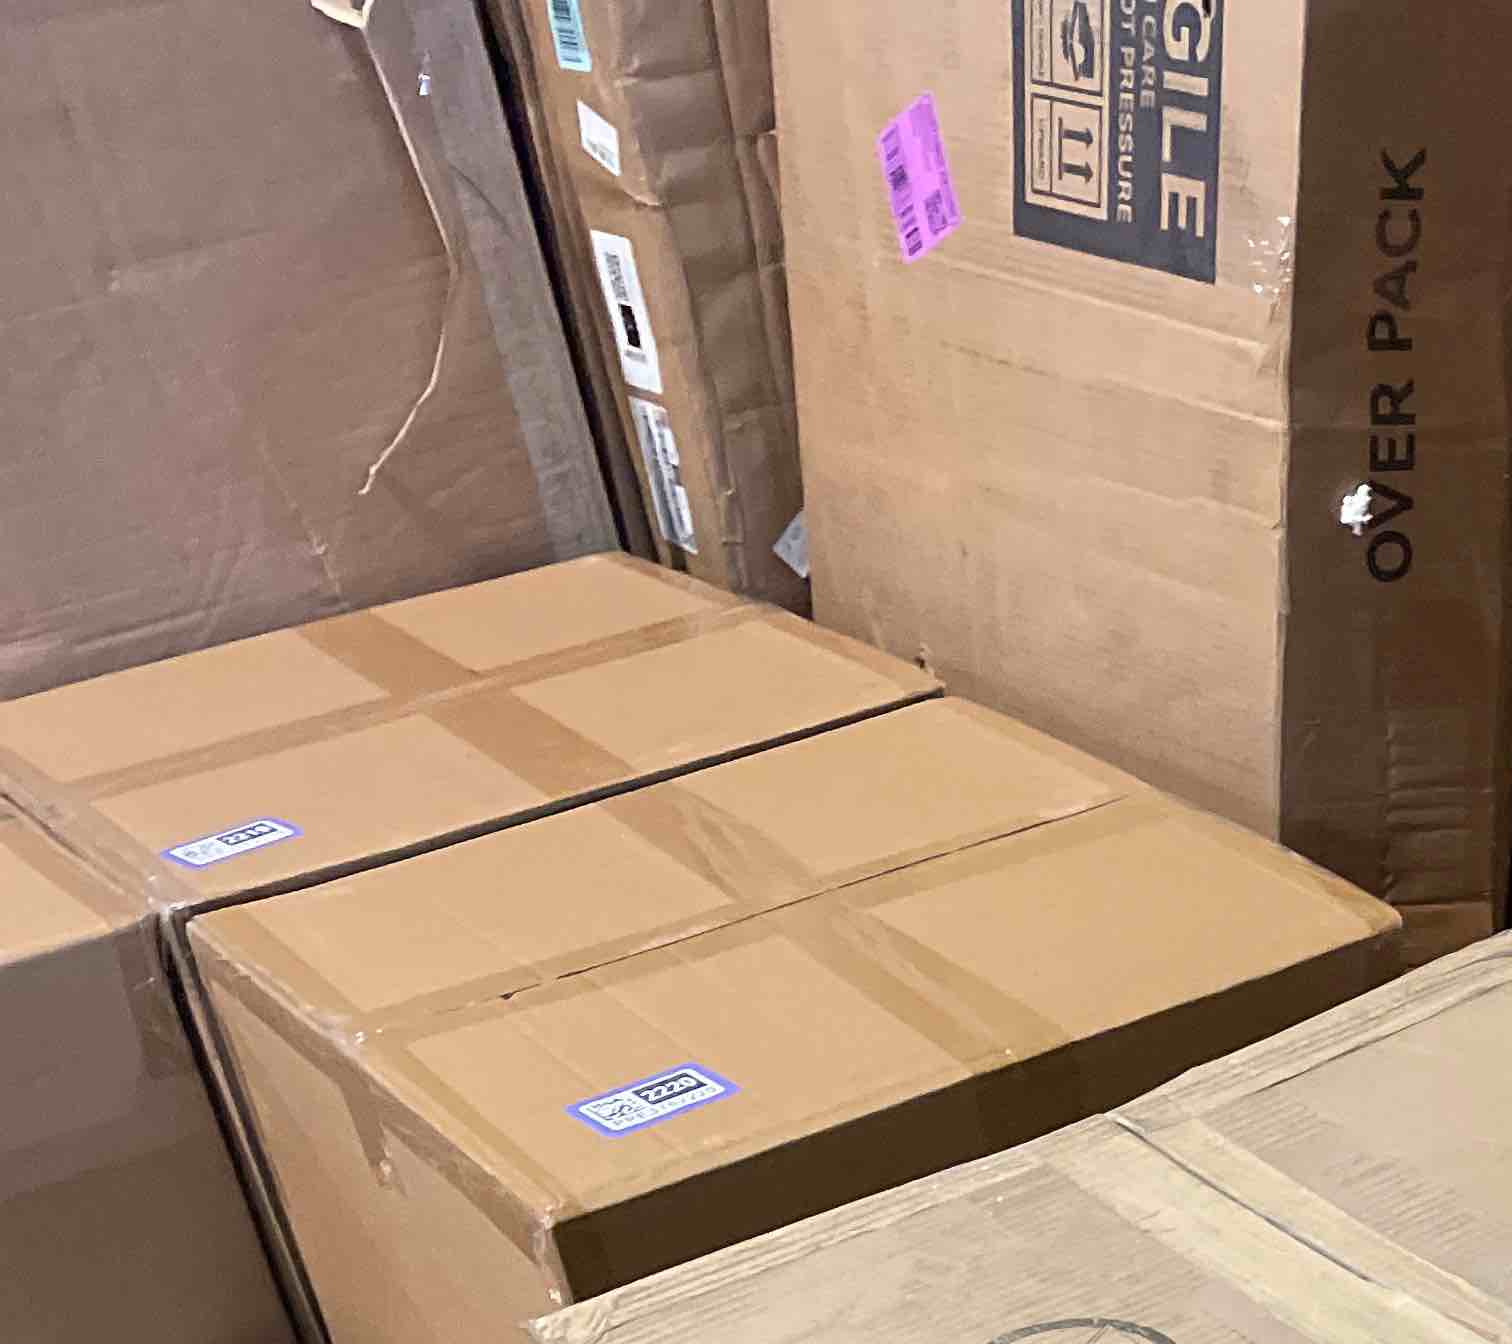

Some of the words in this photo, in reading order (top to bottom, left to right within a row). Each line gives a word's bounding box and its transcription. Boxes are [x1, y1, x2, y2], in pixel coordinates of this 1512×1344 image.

[1117, 46, 1136, 224] PRESSURE
[1140, 14, 1157, 109] CARE
[1367, 147, 1428, 352] PACK
[1366, 378, 1416, 584] OVER
